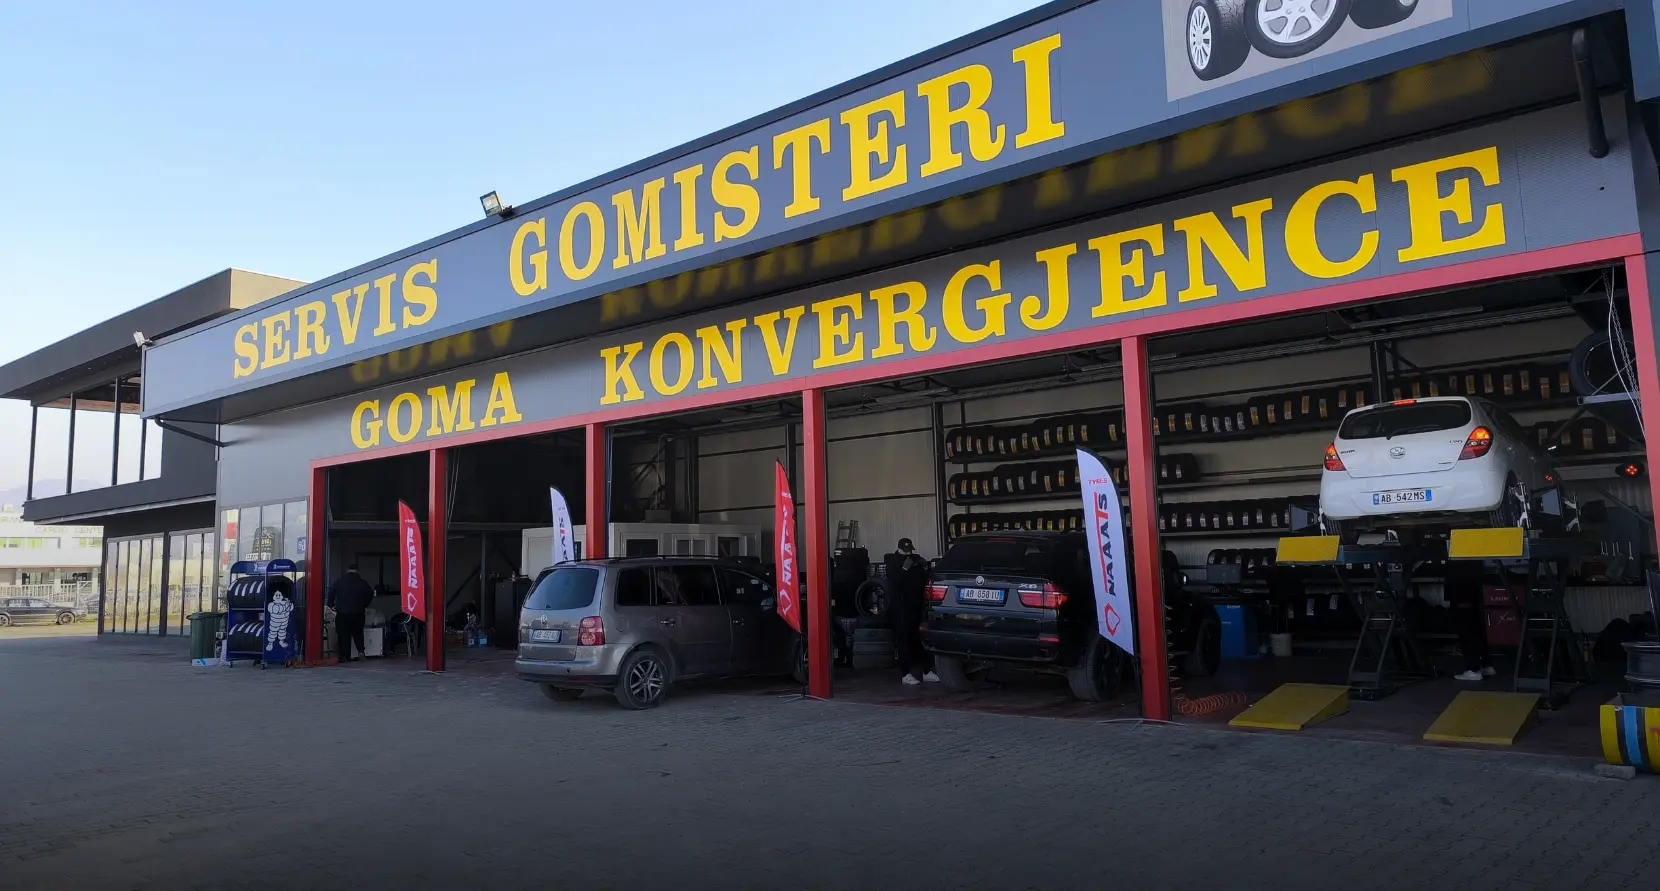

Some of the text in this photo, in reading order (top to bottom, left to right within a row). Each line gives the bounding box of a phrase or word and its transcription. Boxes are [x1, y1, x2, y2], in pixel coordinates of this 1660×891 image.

[234, 33, 1066, 378] SERVIS GOMISTERI
[350, 146, 1506, 448] GOMA KONVERGJENCE
[35, 526, 69, 534] CARGO
[1093, 492, 1116, 596] NAAATS
[1381, 493, 1392, 503] AB
